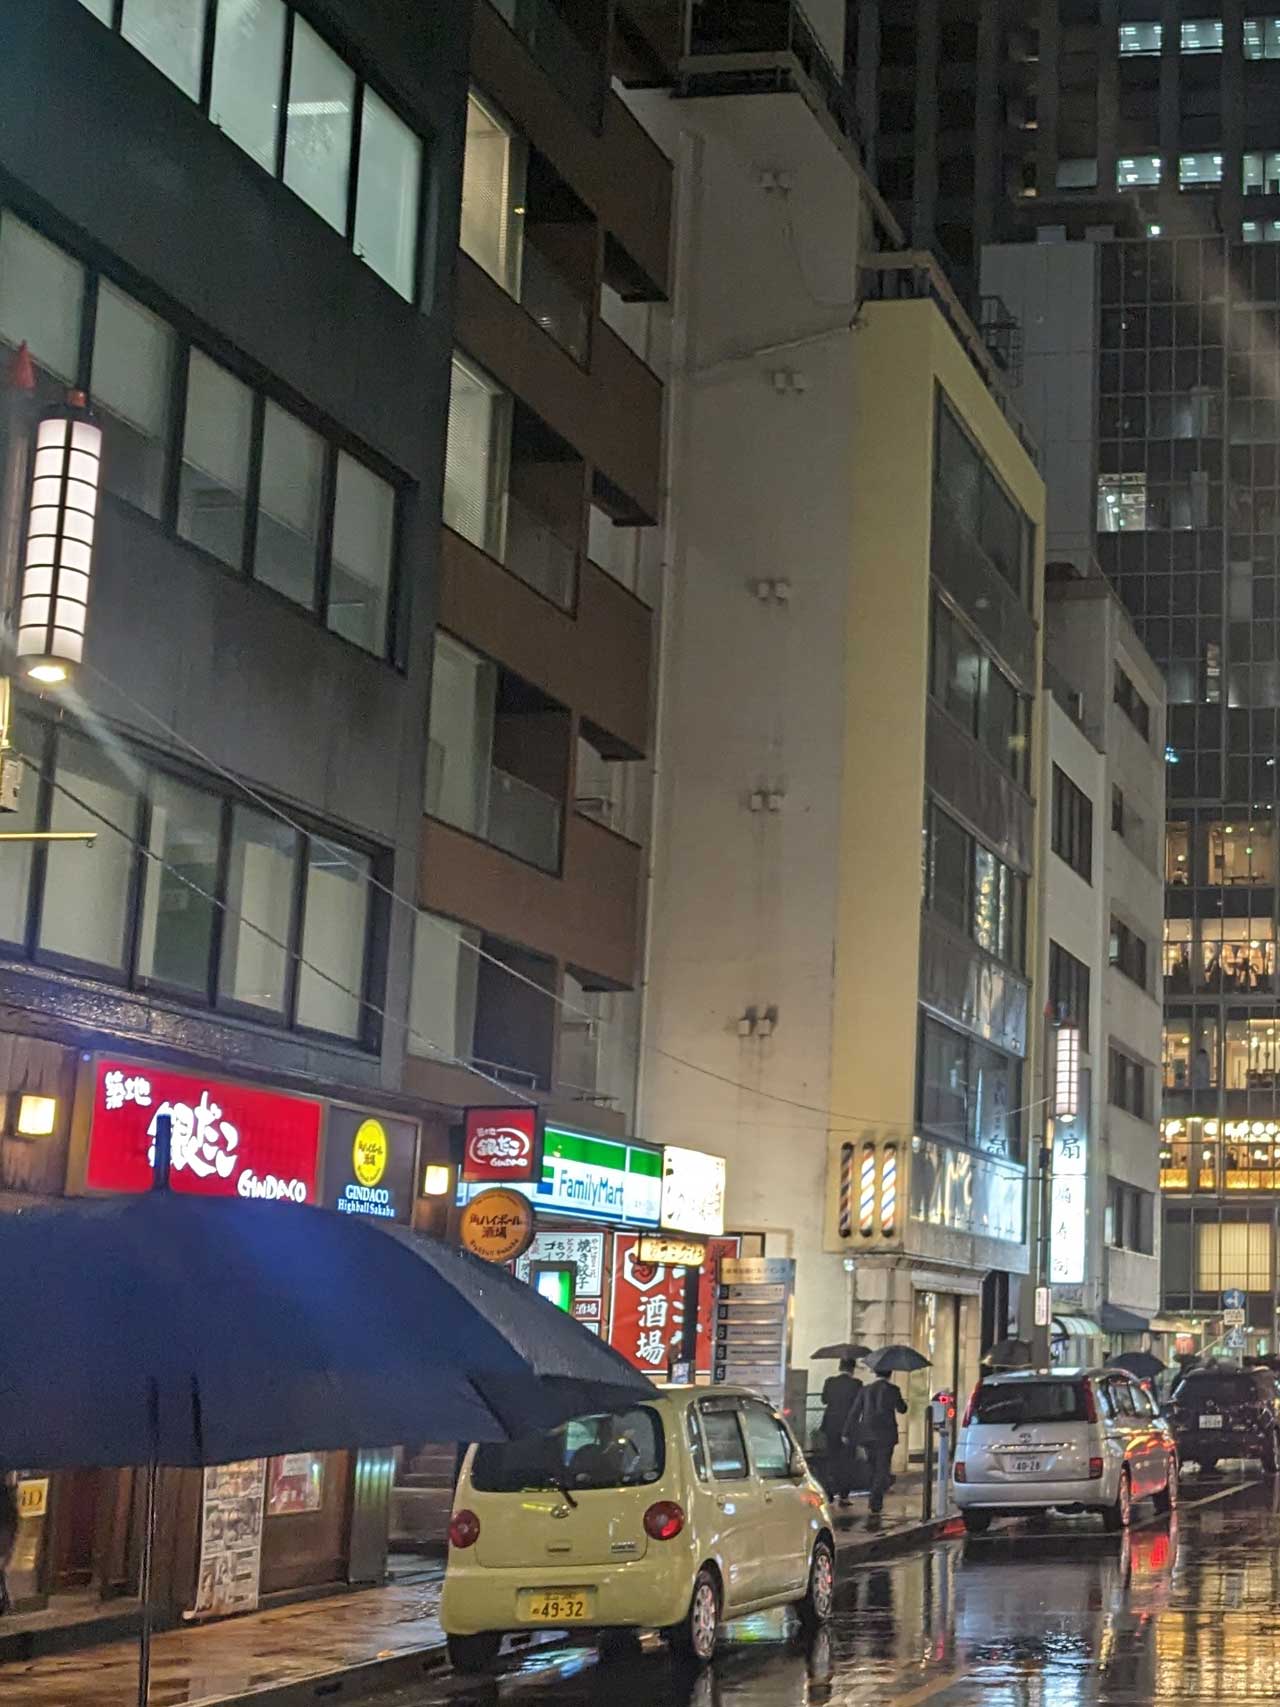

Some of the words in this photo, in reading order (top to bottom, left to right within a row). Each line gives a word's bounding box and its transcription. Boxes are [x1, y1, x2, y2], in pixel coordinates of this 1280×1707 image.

[105, 1071, 151, 1110] 築地
[237, 1169, 306, 1202] GINDACO
[345, 1184, 389, 1204] GINDACO
[559, 1169, 624, 1207] FamilyMart
[337, 1198, 369, 1214] Highball
[577, 1239, 592, 1290] 焼き餃子
[636, 1294, 668, 1365] 酒場
[541, 1601, 584, 1618] 49-32
